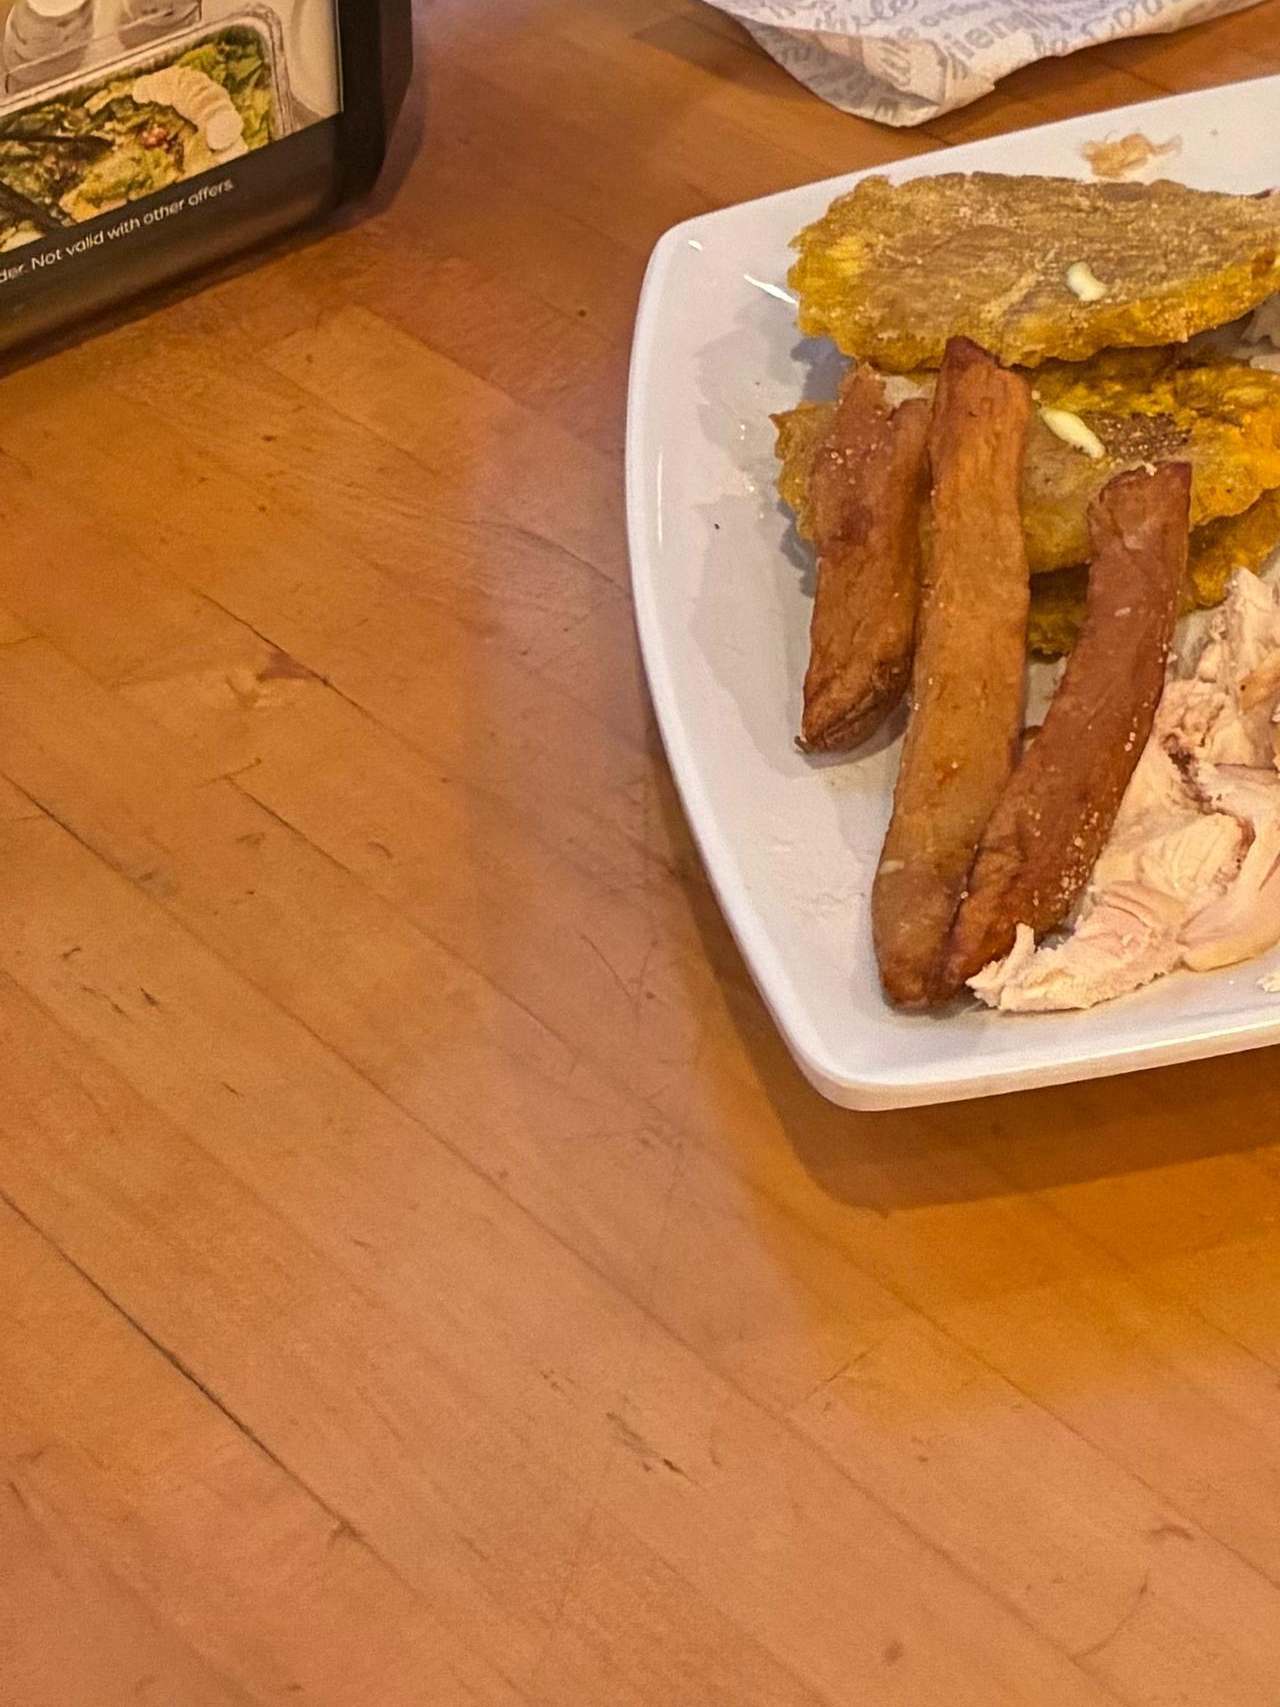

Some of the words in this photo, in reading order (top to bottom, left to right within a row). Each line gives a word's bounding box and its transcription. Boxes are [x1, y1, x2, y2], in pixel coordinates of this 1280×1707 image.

[31, 247, 62, 272] Not
[66, 228, 104, 256] valid
[107, 214, 141, 240] with
[143, 198, 186, 226] other
